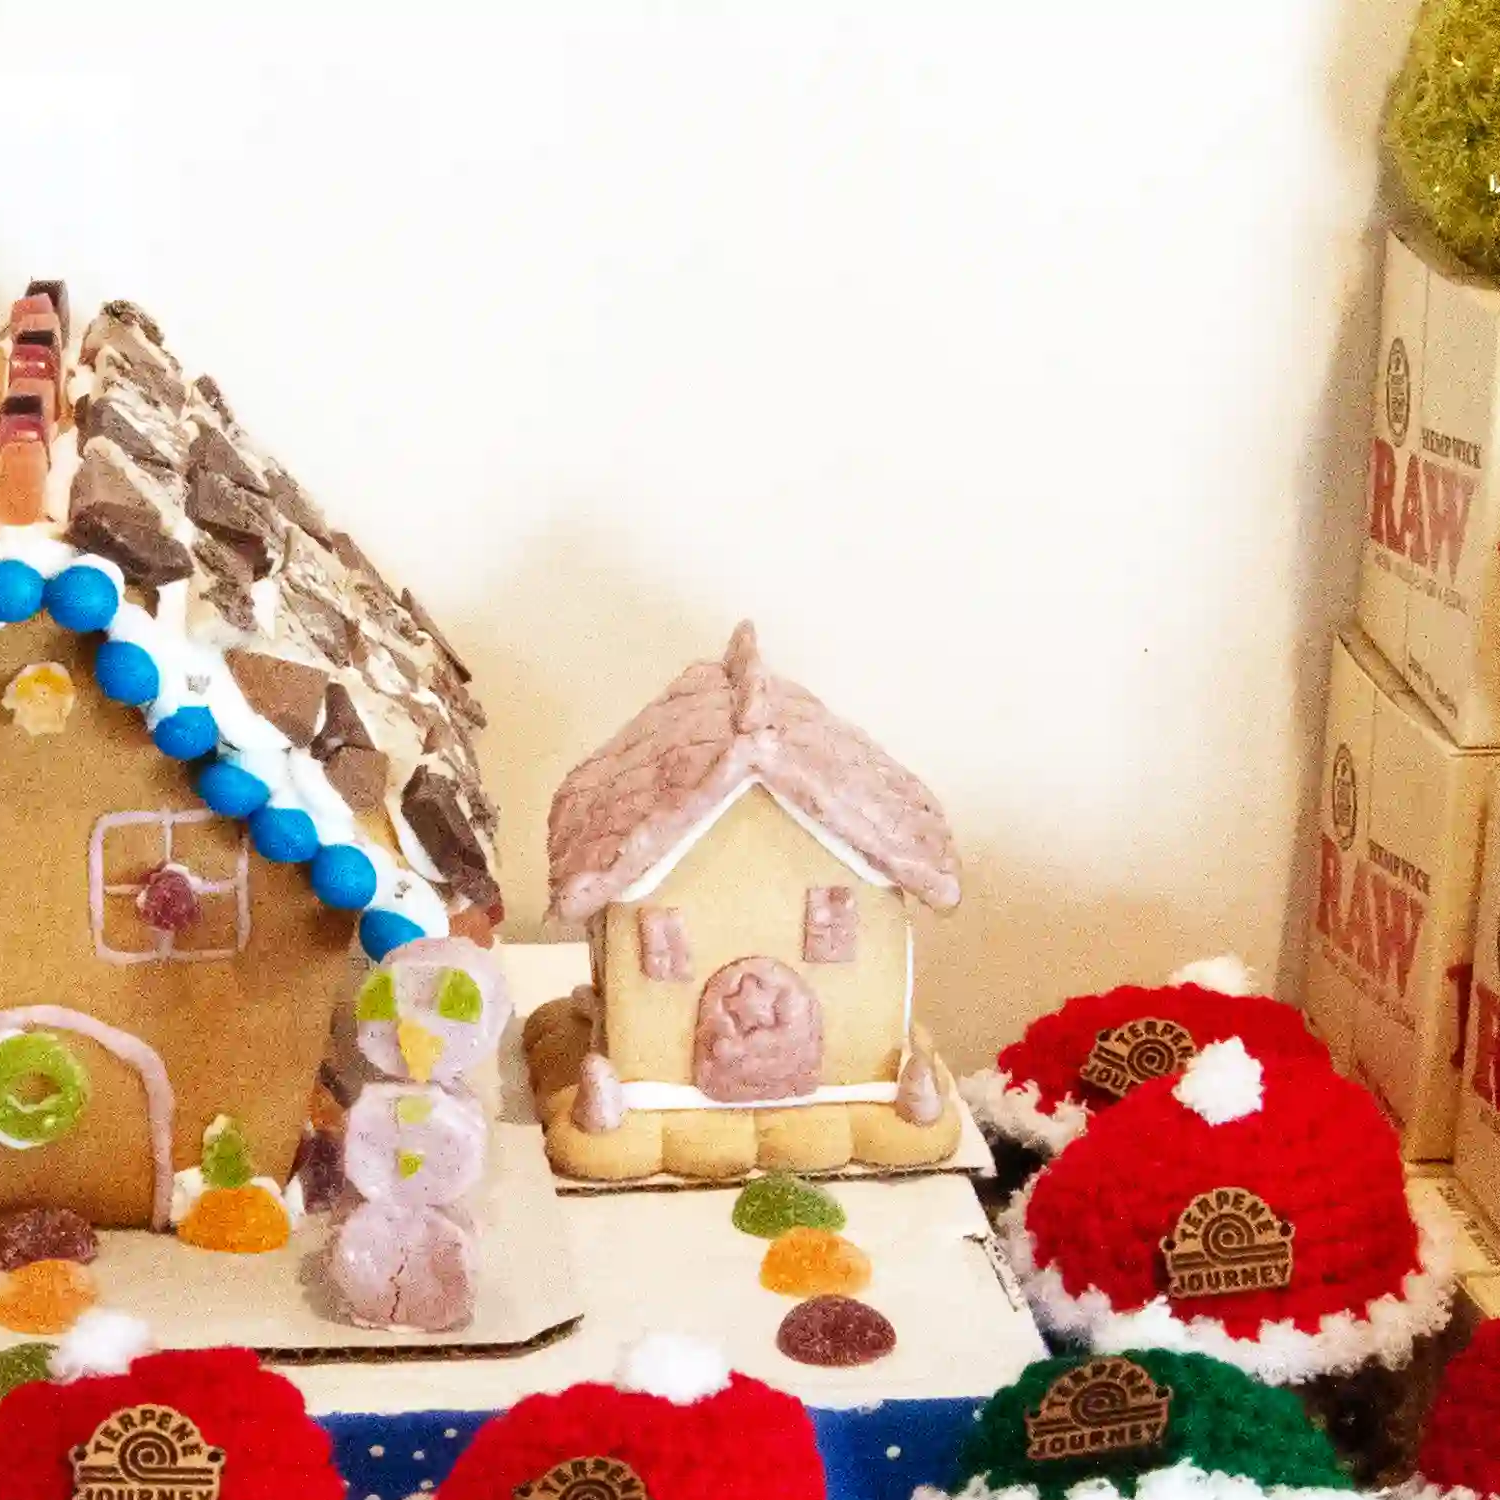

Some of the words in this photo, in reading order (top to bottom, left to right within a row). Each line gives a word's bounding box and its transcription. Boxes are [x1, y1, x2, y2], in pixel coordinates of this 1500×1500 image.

[1370, 436, 1476, 585] RAW
[1316, 833, 1428, 997] RAW
[1115, 1021, 1194, 1059] TERPEN
[1180, 1191, 1275, 1240] TERPENE
[1173, 1263, 1289, 1293] JOURNEY
[94, 1409, 202, 1457] TERPENE
[1033, 1421, 1161, 1455] JOURNEY
